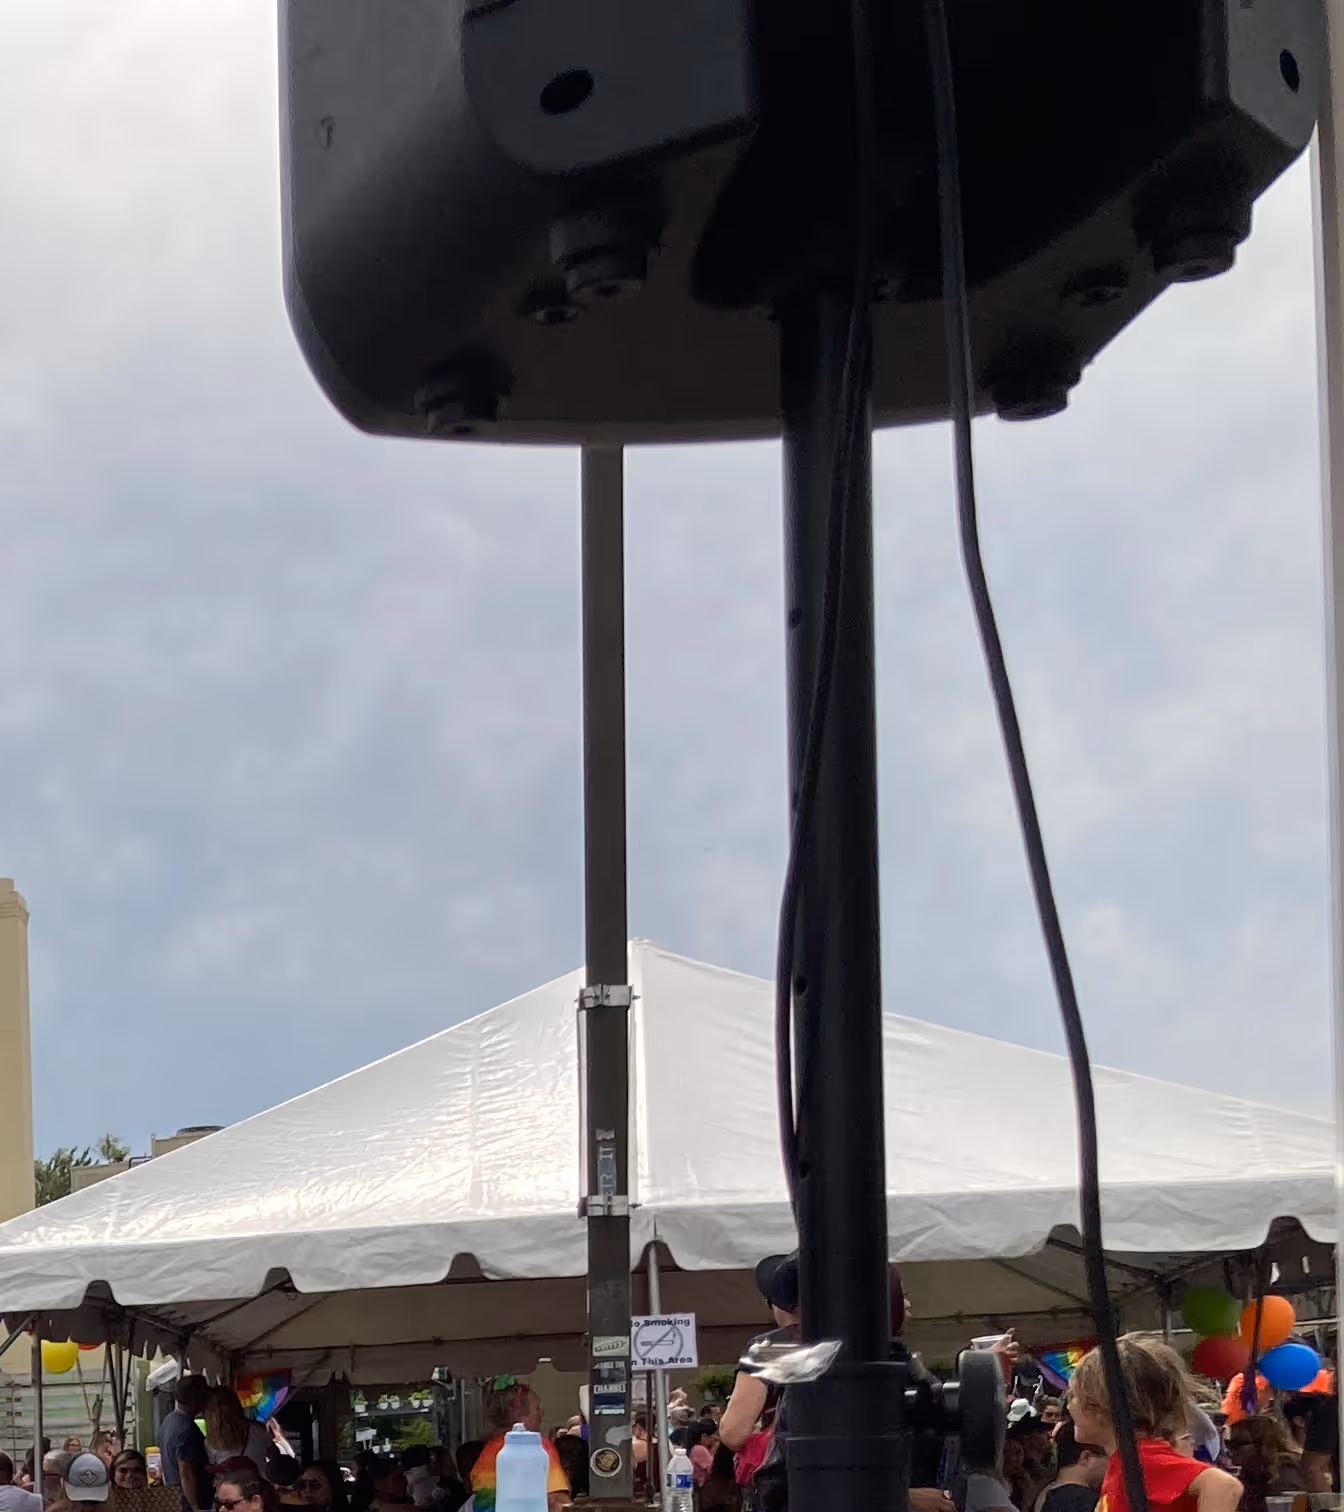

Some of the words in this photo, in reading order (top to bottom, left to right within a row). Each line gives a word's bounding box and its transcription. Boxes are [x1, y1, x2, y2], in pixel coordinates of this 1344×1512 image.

[643, 1318, 690, 1327] Smoking
[642, 1358, 664, 1366] This
[667, 1356, 693, 1364] Area
